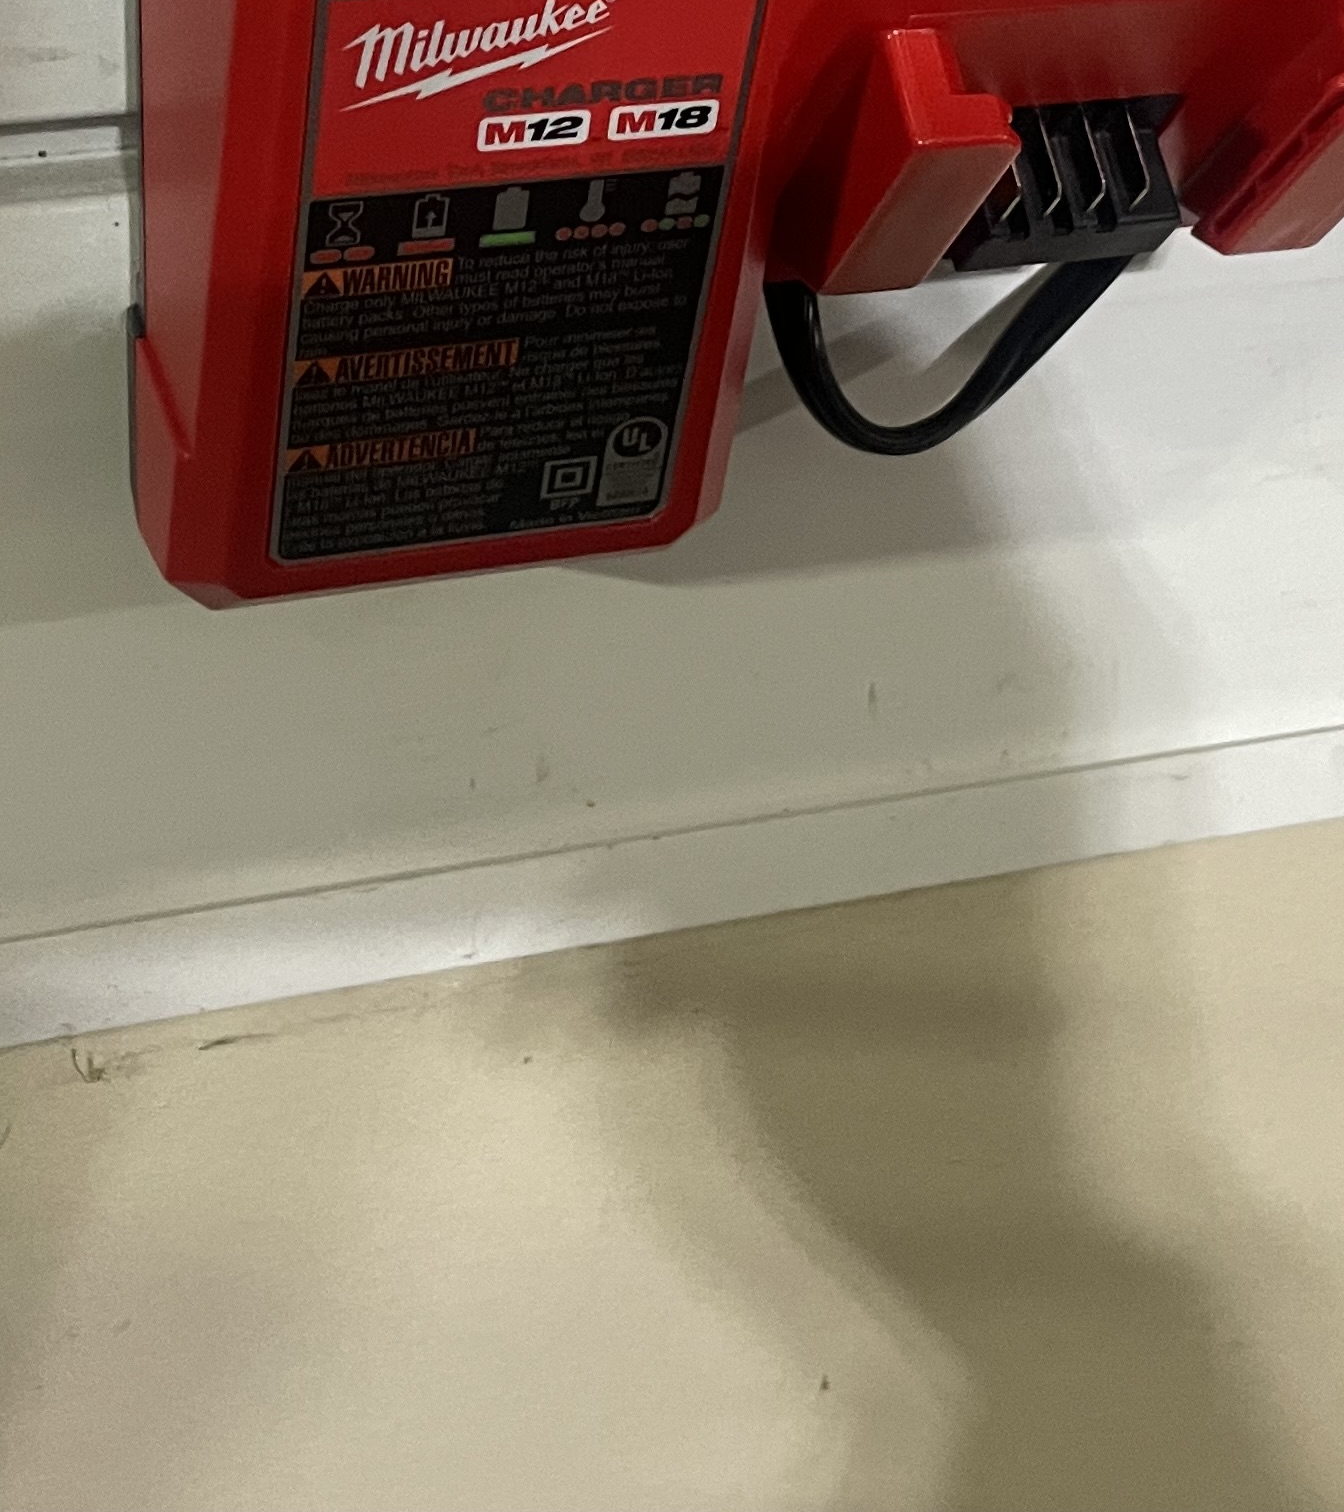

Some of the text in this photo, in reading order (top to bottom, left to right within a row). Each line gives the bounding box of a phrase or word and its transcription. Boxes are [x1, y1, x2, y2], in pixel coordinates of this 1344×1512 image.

[483, 73, 724, 112] CHARGER
[484, 106, 714, 146] M12 M18
[342, 260, 450, 296] WARNING
[335, 340, 518, 383] AVERTISSEMENT
[326, 429, 473, 469] ADVERTENCIA
[621, 425, 653, 452] UL
